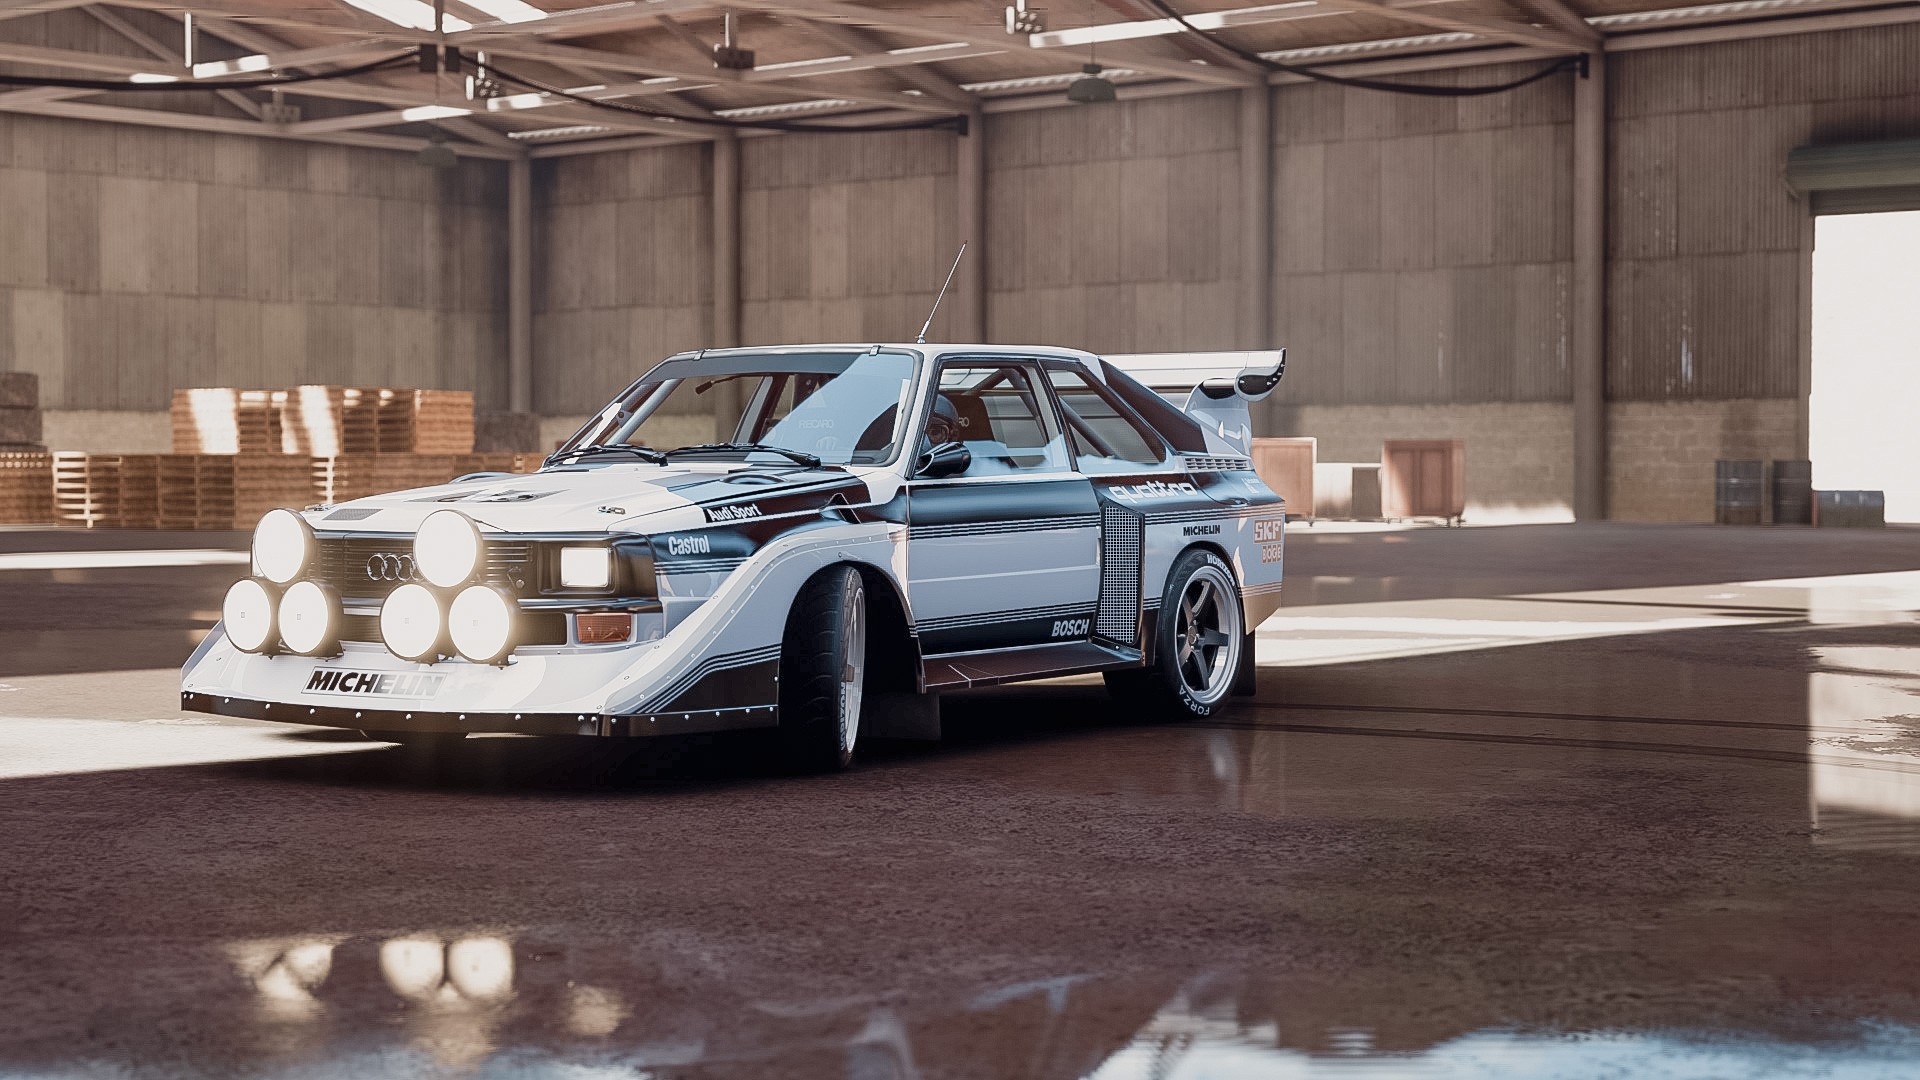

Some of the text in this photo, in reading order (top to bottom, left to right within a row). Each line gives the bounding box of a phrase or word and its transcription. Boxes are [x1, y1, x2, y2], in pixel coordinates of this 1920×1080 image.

[1108, 480, 1198, 504] quattro
[706, 503, 762, 522] Audi Sport
[1183, 524, 1221, 537] MICHELIN
[1254, 521, 1281, 541] SKF
[668, 535, 710, 556] Castrol
[1262, 546, 1281, 562] BOGE
[1051, 618, 1090, 637] BOSCH
[306, 670, 446, 697] MICHELIN
[1179, 685, 1210, 716] FORZA
